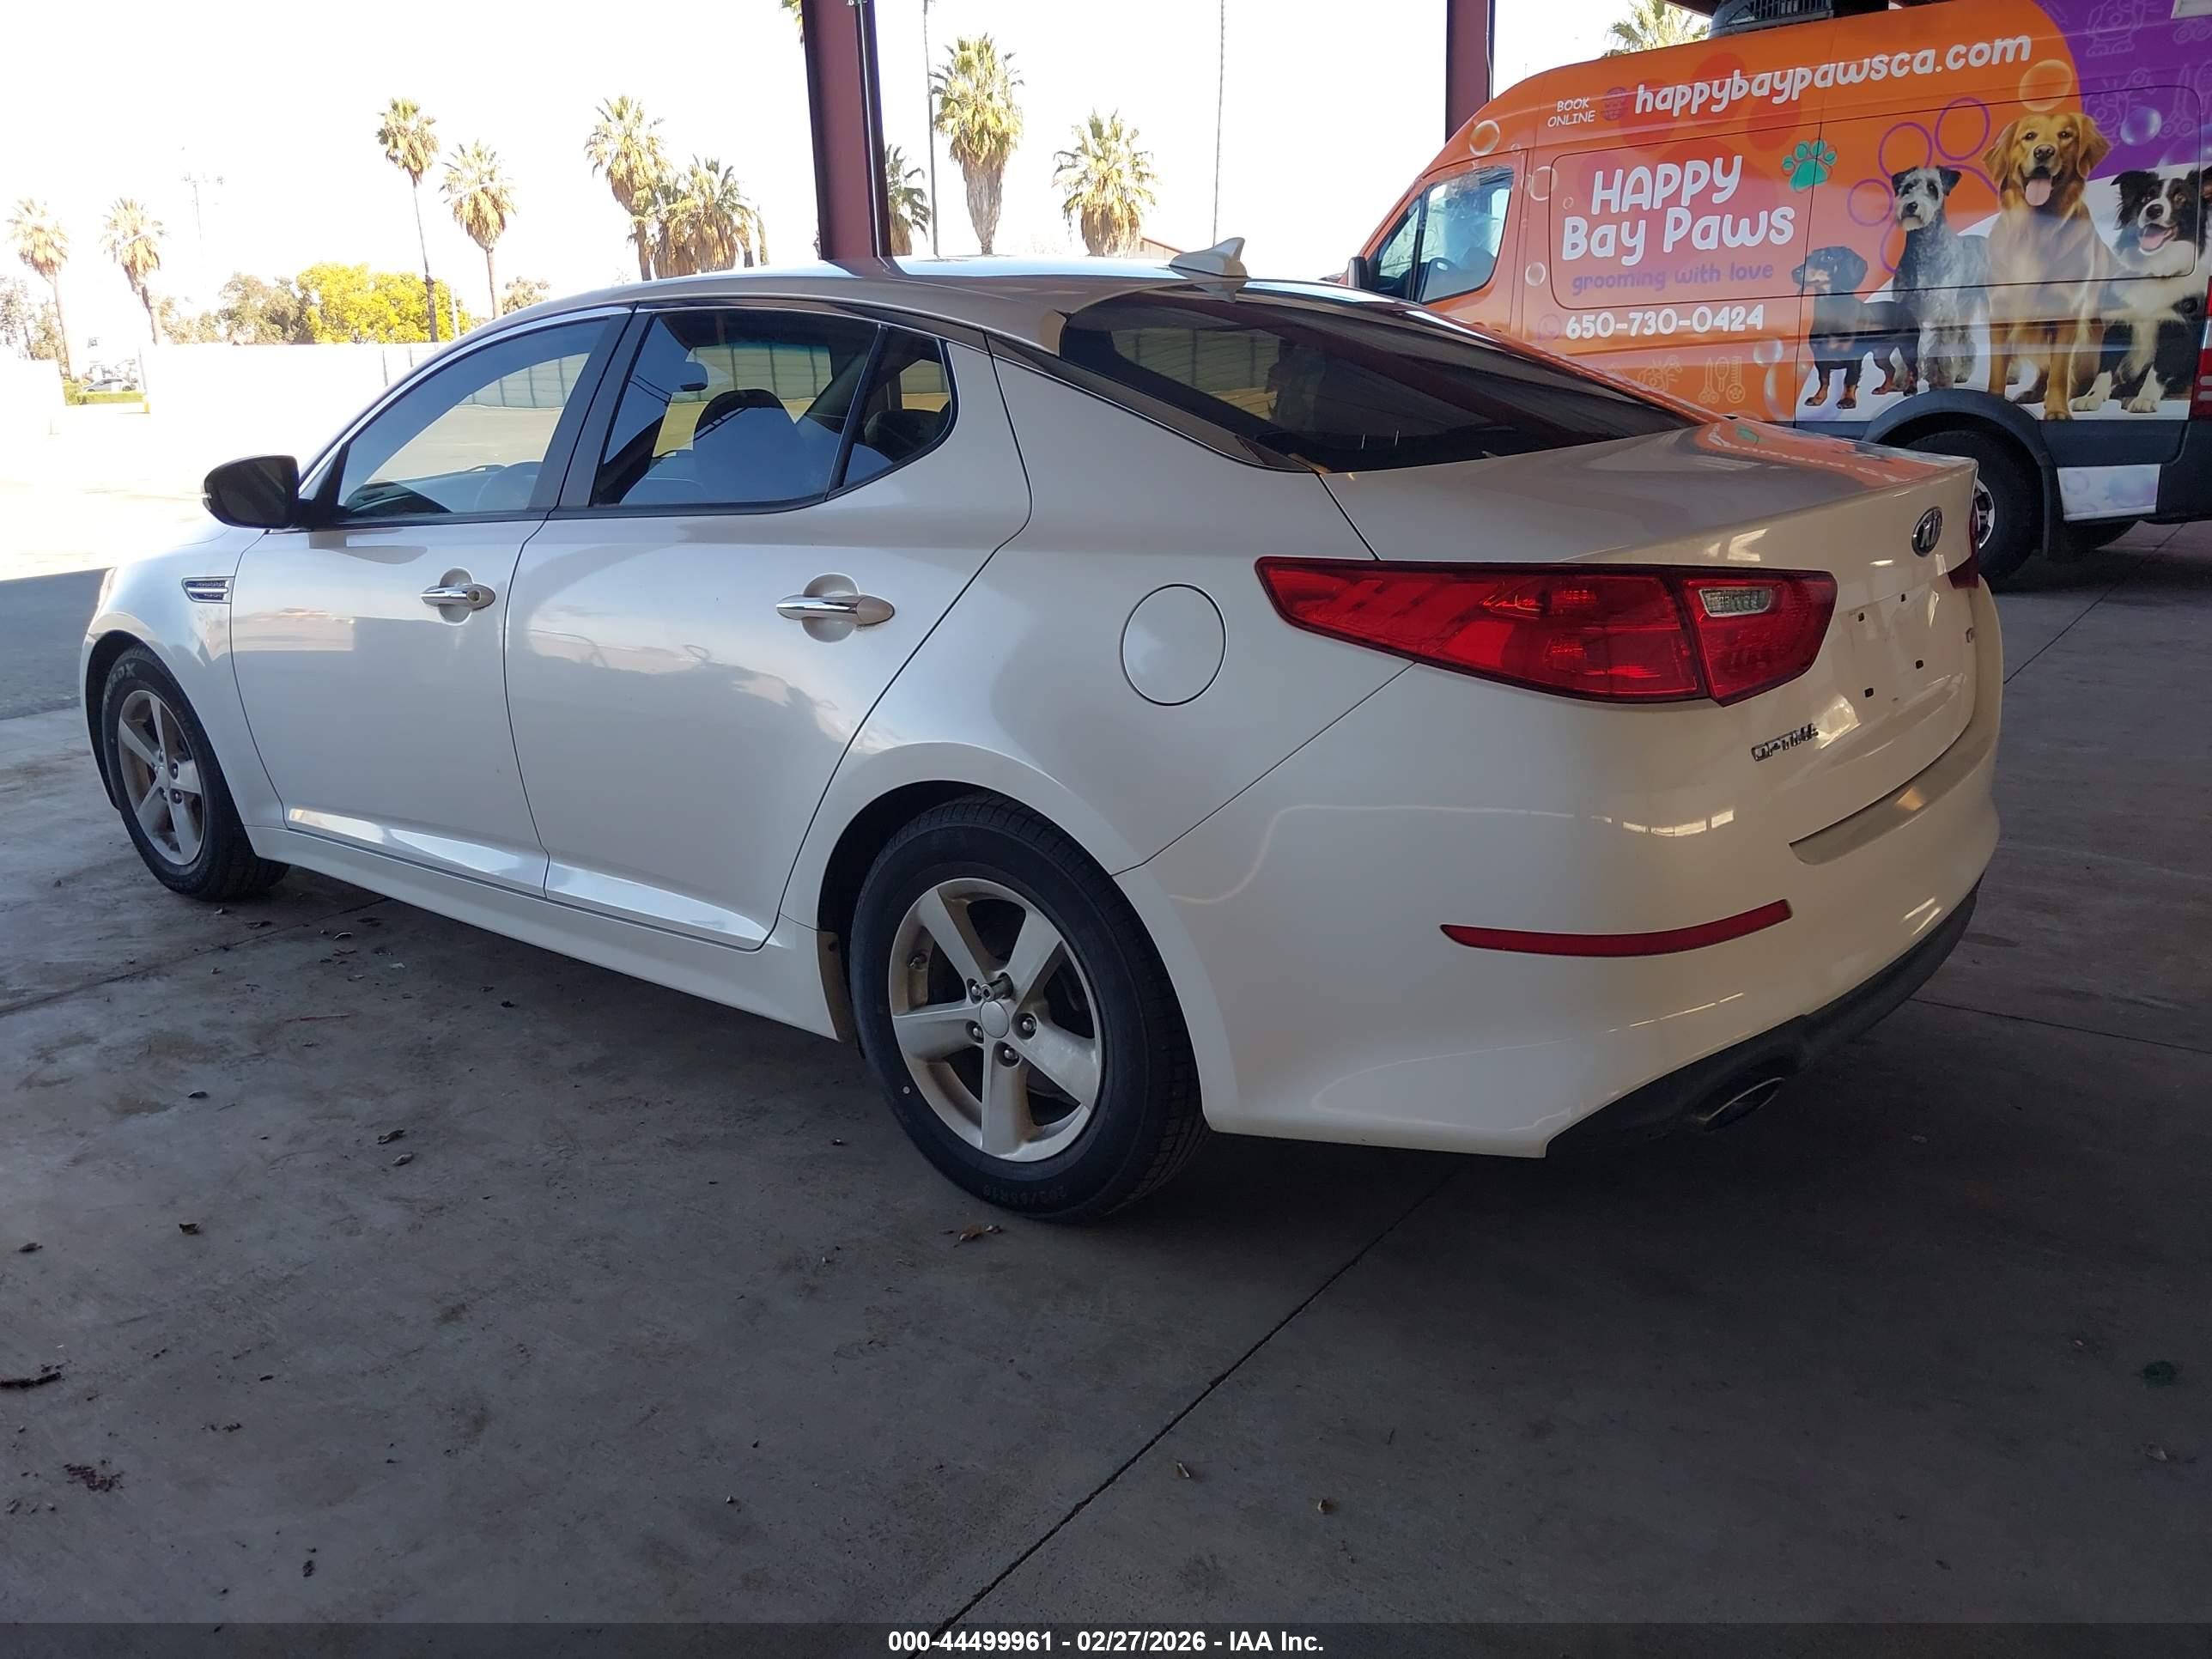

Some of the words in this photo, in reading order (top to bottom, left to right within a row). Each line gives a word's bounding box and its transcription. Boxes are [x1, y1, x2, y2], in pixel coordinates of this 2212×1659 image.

[1634, 35, 2032, 117] happybaypawsca.com
[1547, 110, 1595, 127] ONLINE
[1557, 96, 1589, 112] BOOK
[1591, 155, 1743, 215] HAPPY
[1561, 215, 1647, 267] Bay
[1662, 206, 1796, 253] Paws
[1571, 269, 1667, 296] grooming
[1674, 267, 1722, 285] with
[1729, 261, 1774, 281] love
[1565, 304, 1765, 340] 650-730-0424
